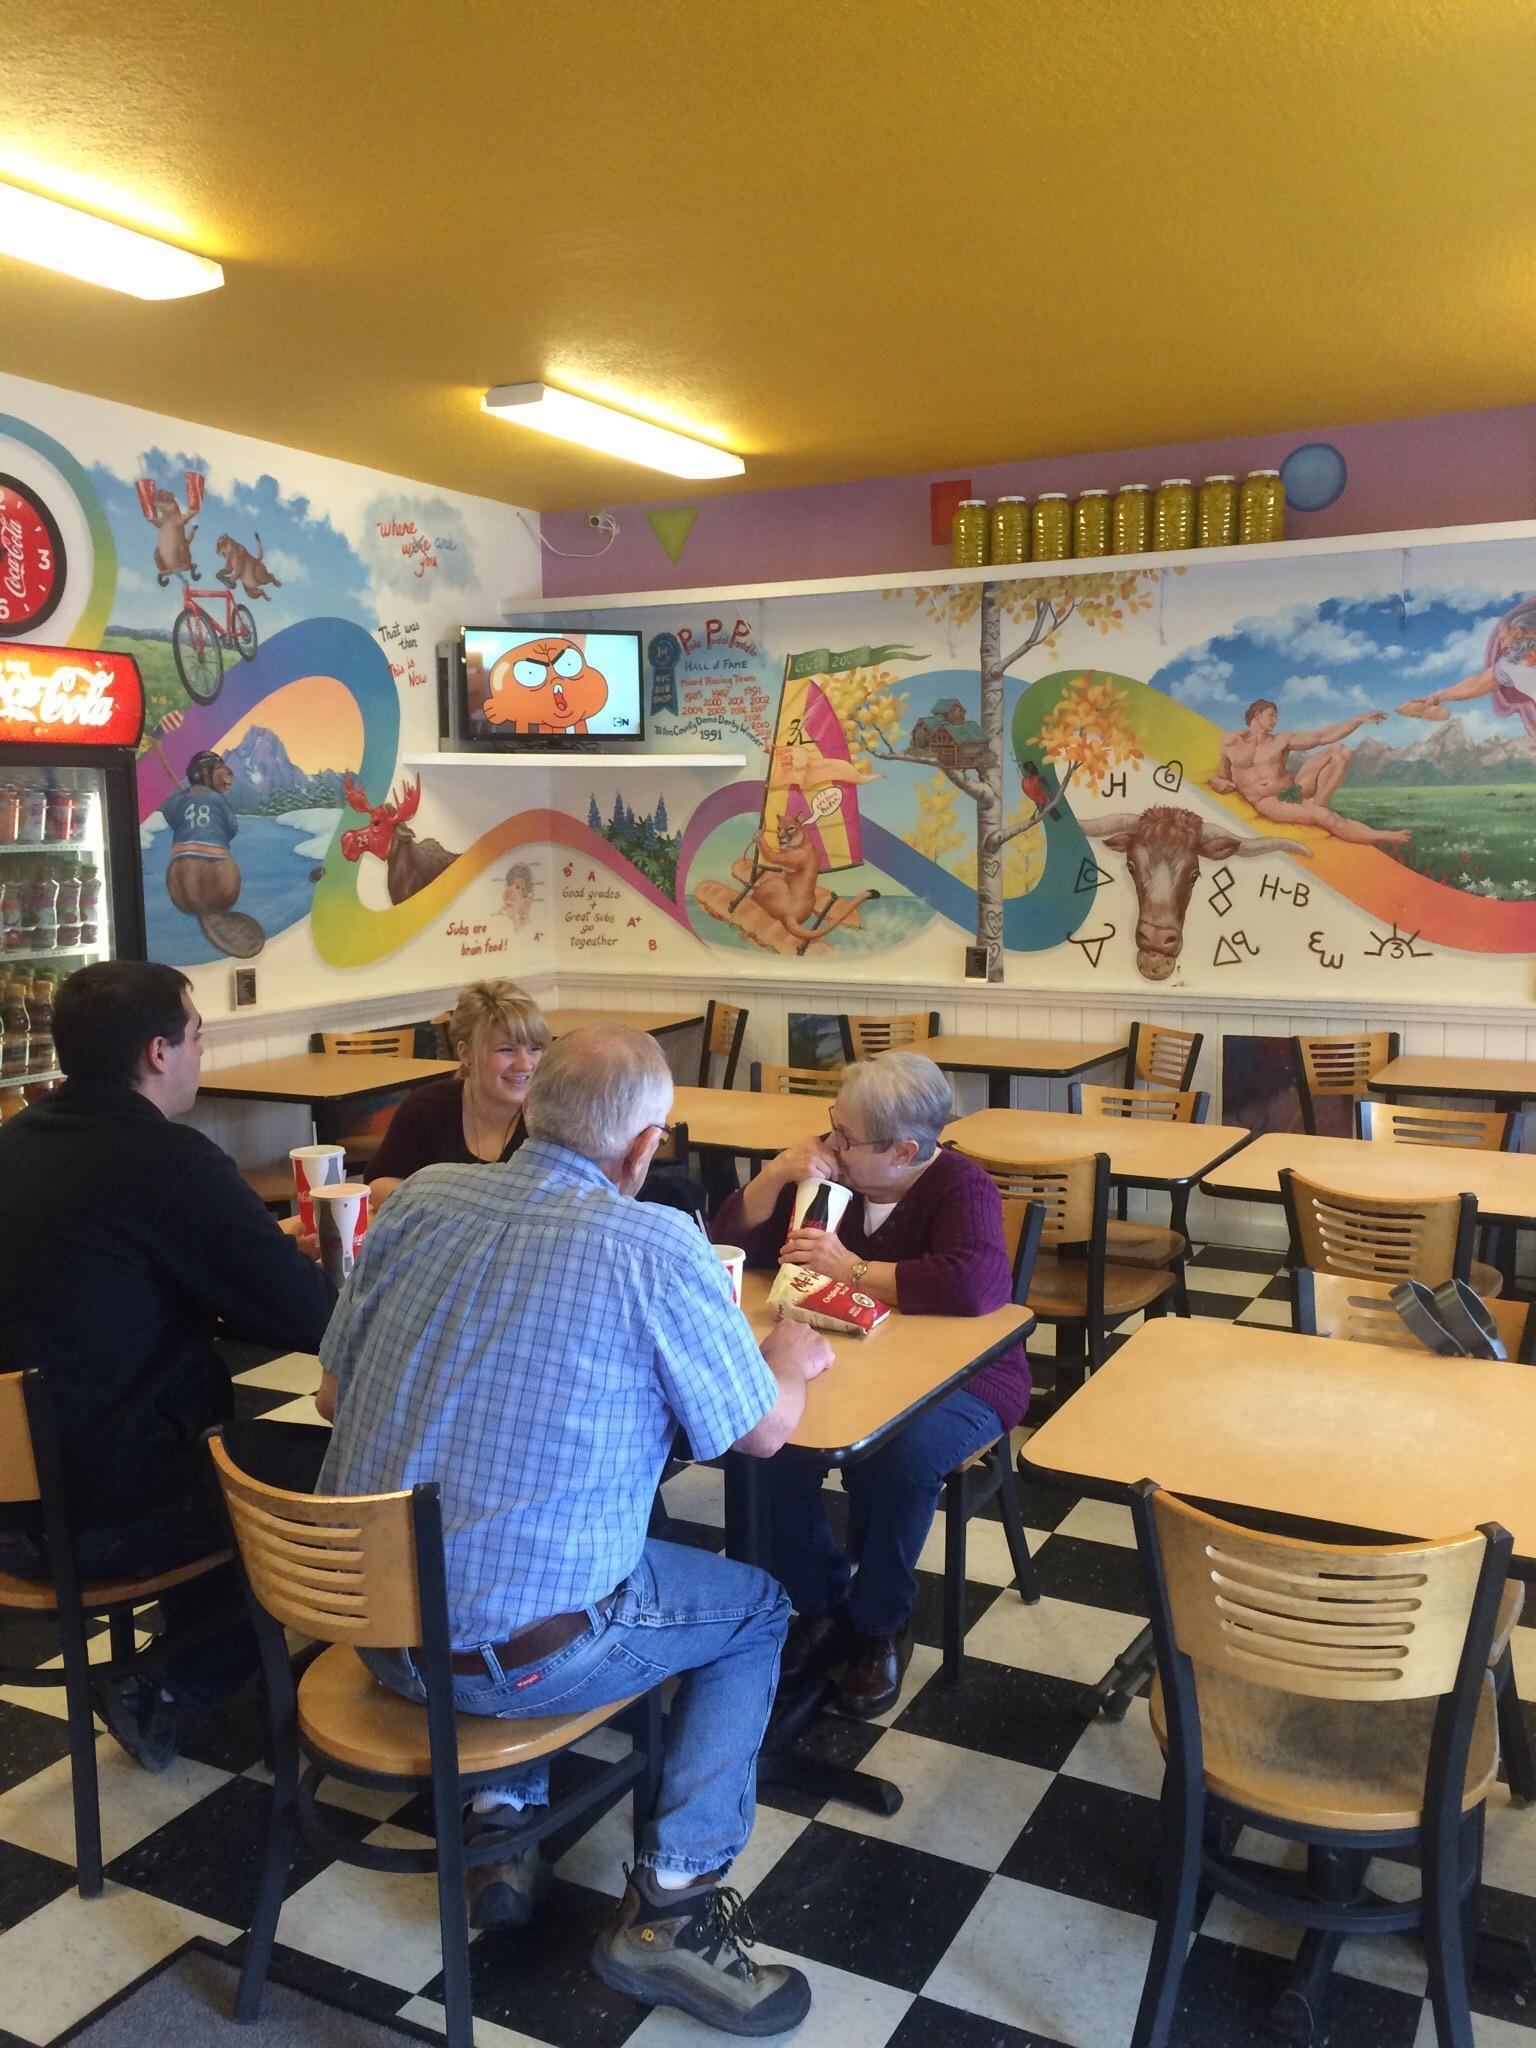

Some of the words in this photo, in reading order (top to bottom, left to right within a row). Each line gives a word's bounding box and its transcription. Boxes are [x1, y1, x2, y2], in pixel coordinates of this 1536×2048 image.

[38, 549, 50, 570] 3
[414, 555, 438, 578] you
[378, 621, 401, 642] That
[695, 716, 717, 726] Demo
[718, 715, 740, 733] Derby
[700, 729, 722, 741] 1991
[184, 803, 210, 829] 48
[357, 835, 369, 848] 24
[562, 886, 585, 898] Good
[587, 886, 621, 901] grades
[565, 912, 591, 922] Great
[446, 920, 470, 936] Subs
[472, 924, 488, 935] are
[580, 925, 594, 935] go
[461, 938, 483, 957] brain
[648, 939, 658, 951] B
